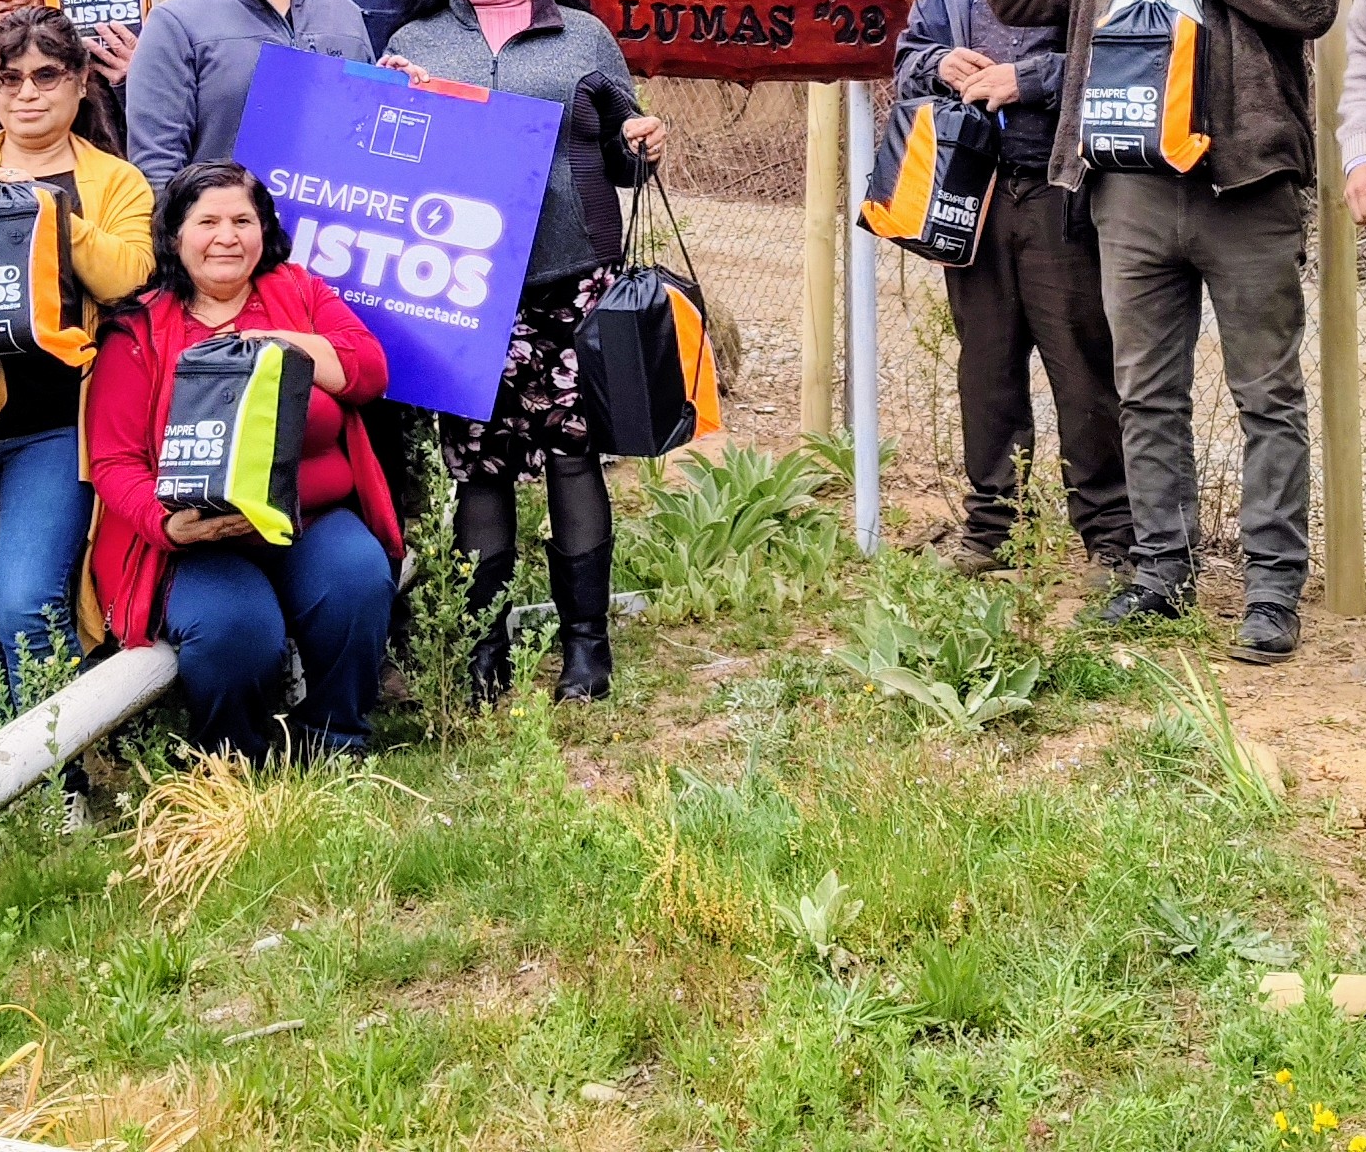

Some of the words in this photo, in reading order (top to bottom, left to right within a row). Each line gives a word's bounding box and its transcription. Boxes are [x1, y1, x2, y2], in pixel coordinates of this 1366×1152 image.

[63, 1, 140, 23] LISTOS
[1085, 88, 1127, 99] SIEMPRE
[1083, 101, 1158, 121] LISTOS
[267, 168, 410, 224] SIEMPRE
[931, 200, 977, 228] LISTOS
[284, 215, 494, 308] ISTOS
[343, 289, 383, 308] estar
[384, 297, 481, 330] conectados
[159, 438, 225, 461] ISTOS
